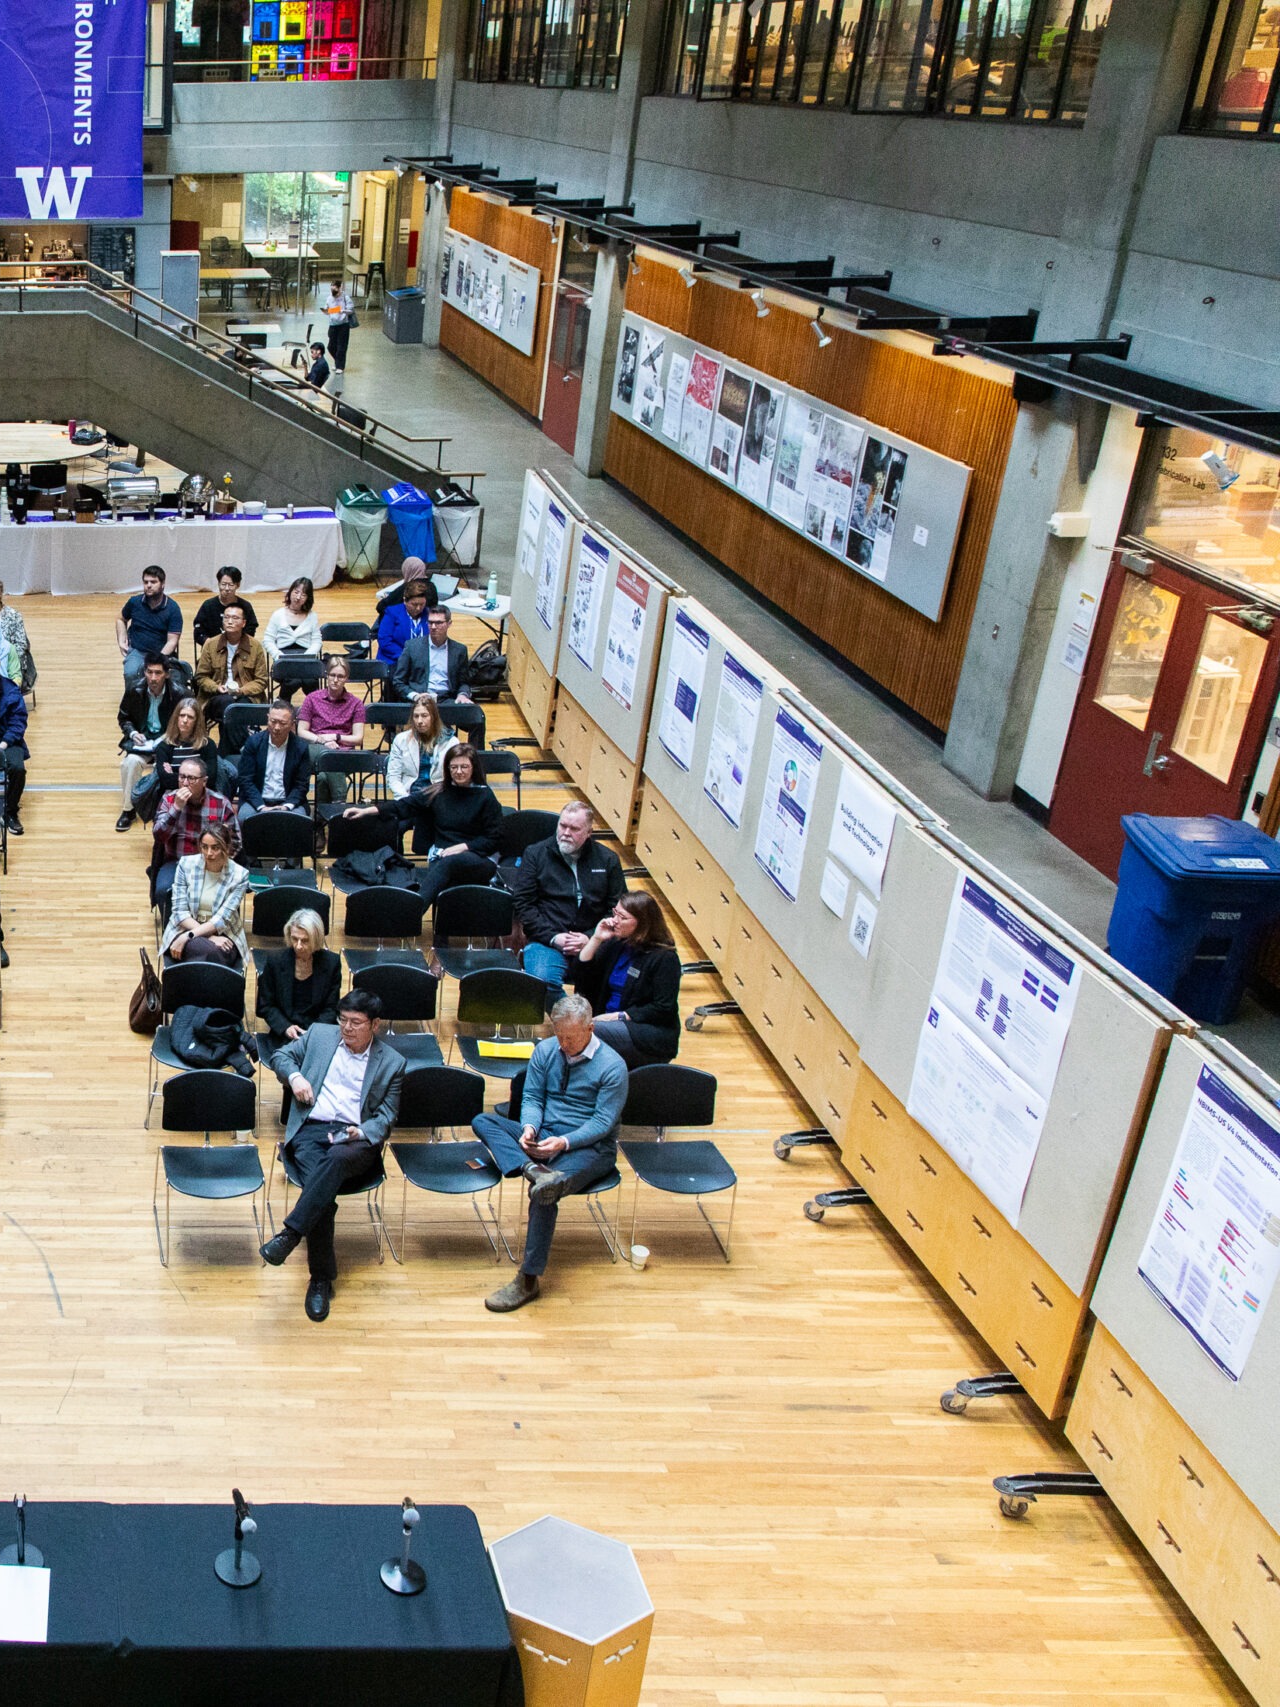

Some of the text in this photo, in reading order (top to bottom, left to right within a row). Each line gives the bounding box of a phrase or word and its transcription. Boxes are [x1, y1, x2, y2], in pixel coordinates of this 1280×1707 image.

[74, 0, 94, 146] RONMENTS
[16, 167, 93, 220] W
[1162, 445, 1178, 461] 132
[1156, 464, 1206, 490] Fabrication Lab
[841, 803, 883, 849] Building Information
[843, 820, 876, 857] and Technology
[1197, 1097, 1227, 1127] NBIMS-US
[1235, 1131, 1278, 1177] Implementation
